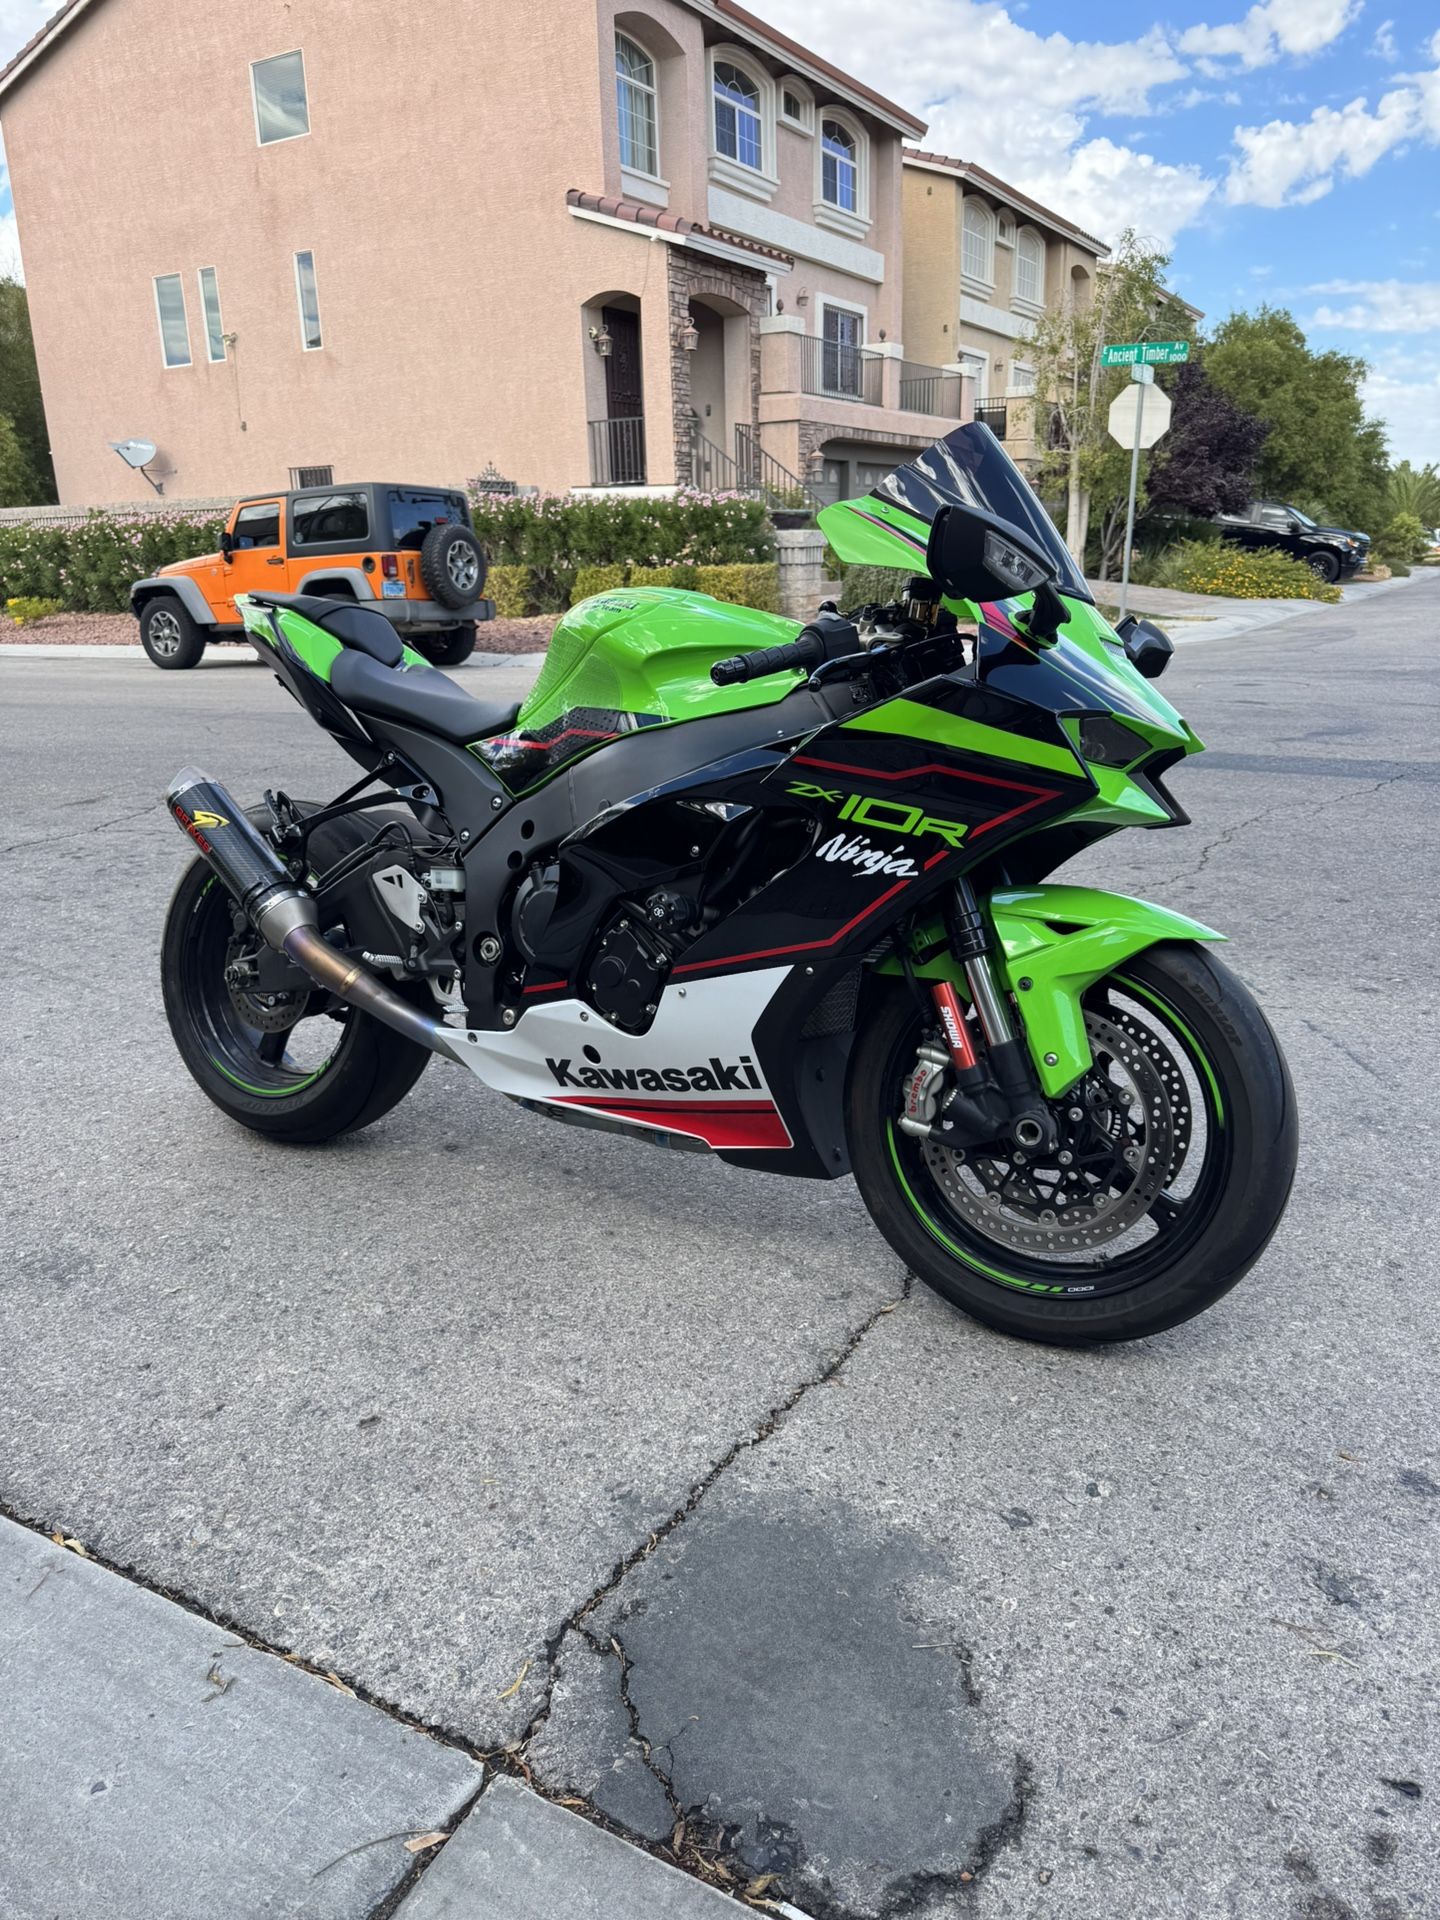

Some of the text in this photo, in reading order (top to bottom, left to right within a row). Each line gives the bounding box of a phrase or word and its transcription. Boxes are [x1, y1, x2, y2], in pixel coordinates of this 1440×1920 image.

[1107, 347, 1138, 363] Ancient
[1142, 346, 1169, 361] Timber
[1169, 353, 1187, 362] 1000
[815, 833, 919, 878] Ninja
[940, 1005, 963, 1049] SHOWA
[1190, 982, 1243, 1047] DUNLOP
[545, 1055, 763, 1093] Kawasaki
[909, 1069, 928, 1114] brembo
